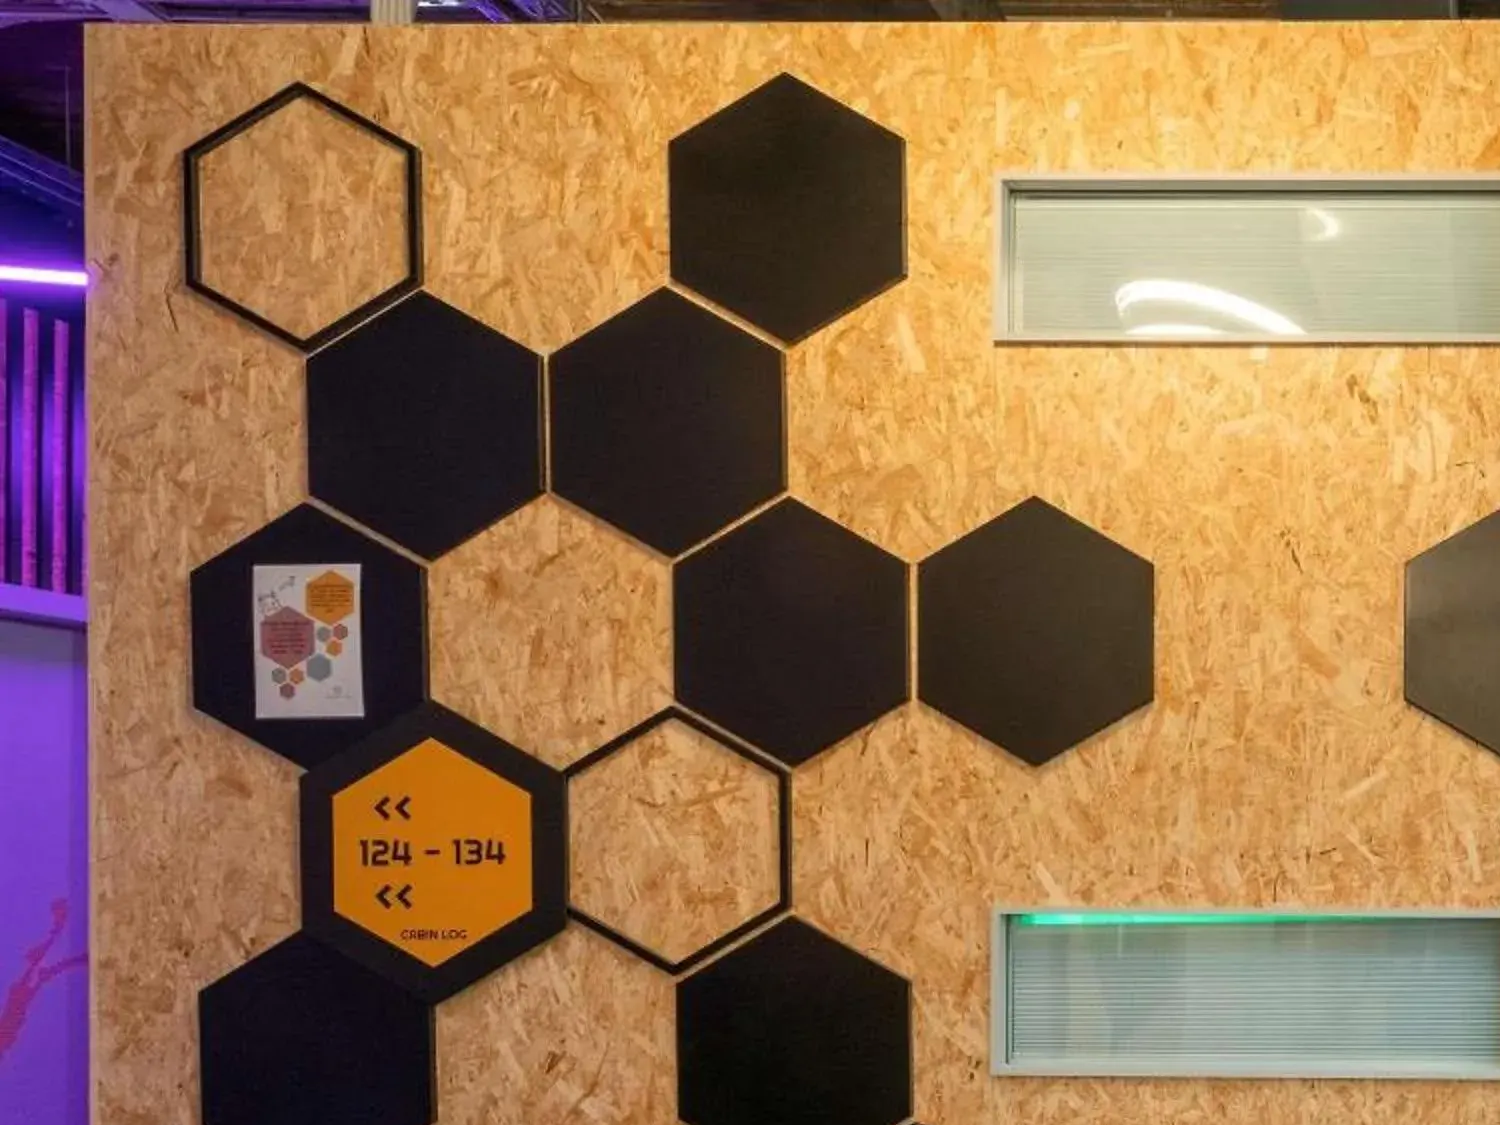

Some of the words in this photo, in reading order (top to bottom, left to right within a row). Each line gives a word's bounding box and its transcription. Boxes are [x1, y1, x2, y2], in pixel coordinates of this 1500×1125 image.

[359, 838, 412, 867] 124
[452, 838, 506, 866] 134
[400, 929, 439, 941] CABIN
[441, 929, 468, 941] LOG
